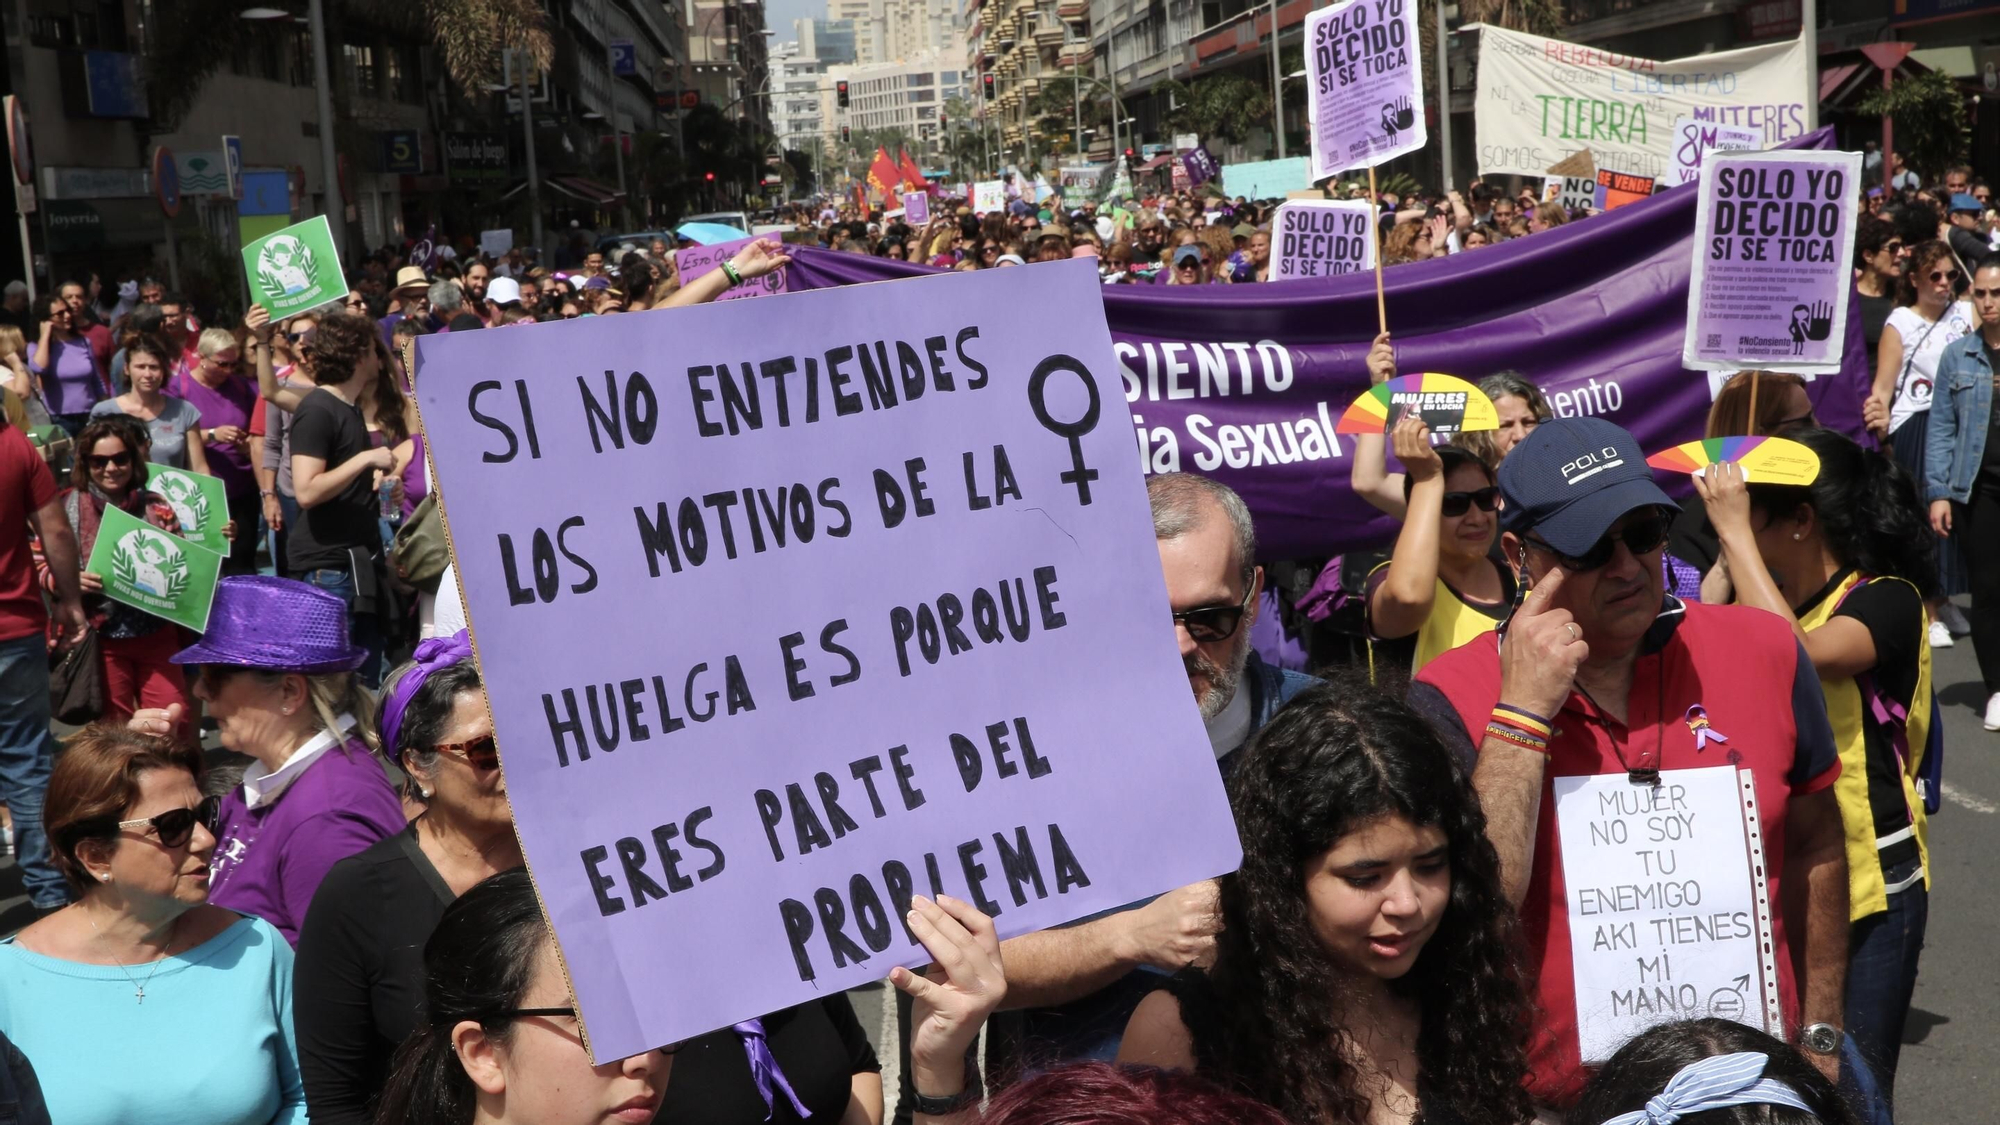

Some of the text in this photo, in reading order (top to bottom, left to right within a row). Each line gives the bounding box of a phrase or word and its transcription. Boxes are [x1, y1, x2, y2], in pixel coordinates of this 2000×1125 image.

[1315, 0, 1402, 45] SOLO YO
[1316, 18, 1405, 75] DECIDO
[1319, 74, 1333, 94] SI
[1339, 63, 1357, 87] SE
[1362, 48, 1407, 77] TOCA
[1611, 71, 1736, 95] LIBERTAD
[1490, 85, 1510, 101] NI
[1534, 94, 1647, 145] TIERRA
[392, 143, 410, 160] 5
[1482, 145, 1542, 170] SOMOS
[1558, 148, 1661, 177] TRITORIO
[1677, 124, 1718, 168] 8M
[1565, 178, 1594, 194] NO
[1598, 170, 1653, 193] SE VENDE
[1717, 167, 1843, 200] SOLO YO
[1563, 196, 1592, 209] NO
[1284, 210, 1366, 235] SOLO YO
[1714, 200, 1839, 238] DECIDO
[680, 248, 736, 271] ESTO QUE
[1282, 233, 1364, 261] DECIDO
[1711, 237, 1835, 263] SI SE TOCA
[1281, 258, 1361, 276] SI SE TOCA
[273, 285, 322, 308] VIVAS NOS QUEREMOS
[1739, 336, 1791, 347] #NoConsiento
[468, 325, 990, 463] SI NO ENTIENDES
[1391, 393, 1466, 404] MUJERES
[1185, 401, 1343, 472] Sexual
[1561, 446, 1617, 478] POLO
[498, 444, 1023, 607] LOS MOTIVOS DE LA
[113, 580, 176, 610] VIVAS NOS QUEREMOS
[541, 565, 1068, 768] HUELGA ES PORQUE
[1598, 784, 1688, 816] MUJER
[580, 716, 1054, 917] ERES PARTE DEL
[1590, 811, 1696, 846] NO SOY
[1635, 849, 1677, 876] TU
[1578, 879, 1701, 916] ENEMIGO
[1593, 921, 1637, 952] AKI
[1611, 983, 1697, 1017] MANO
